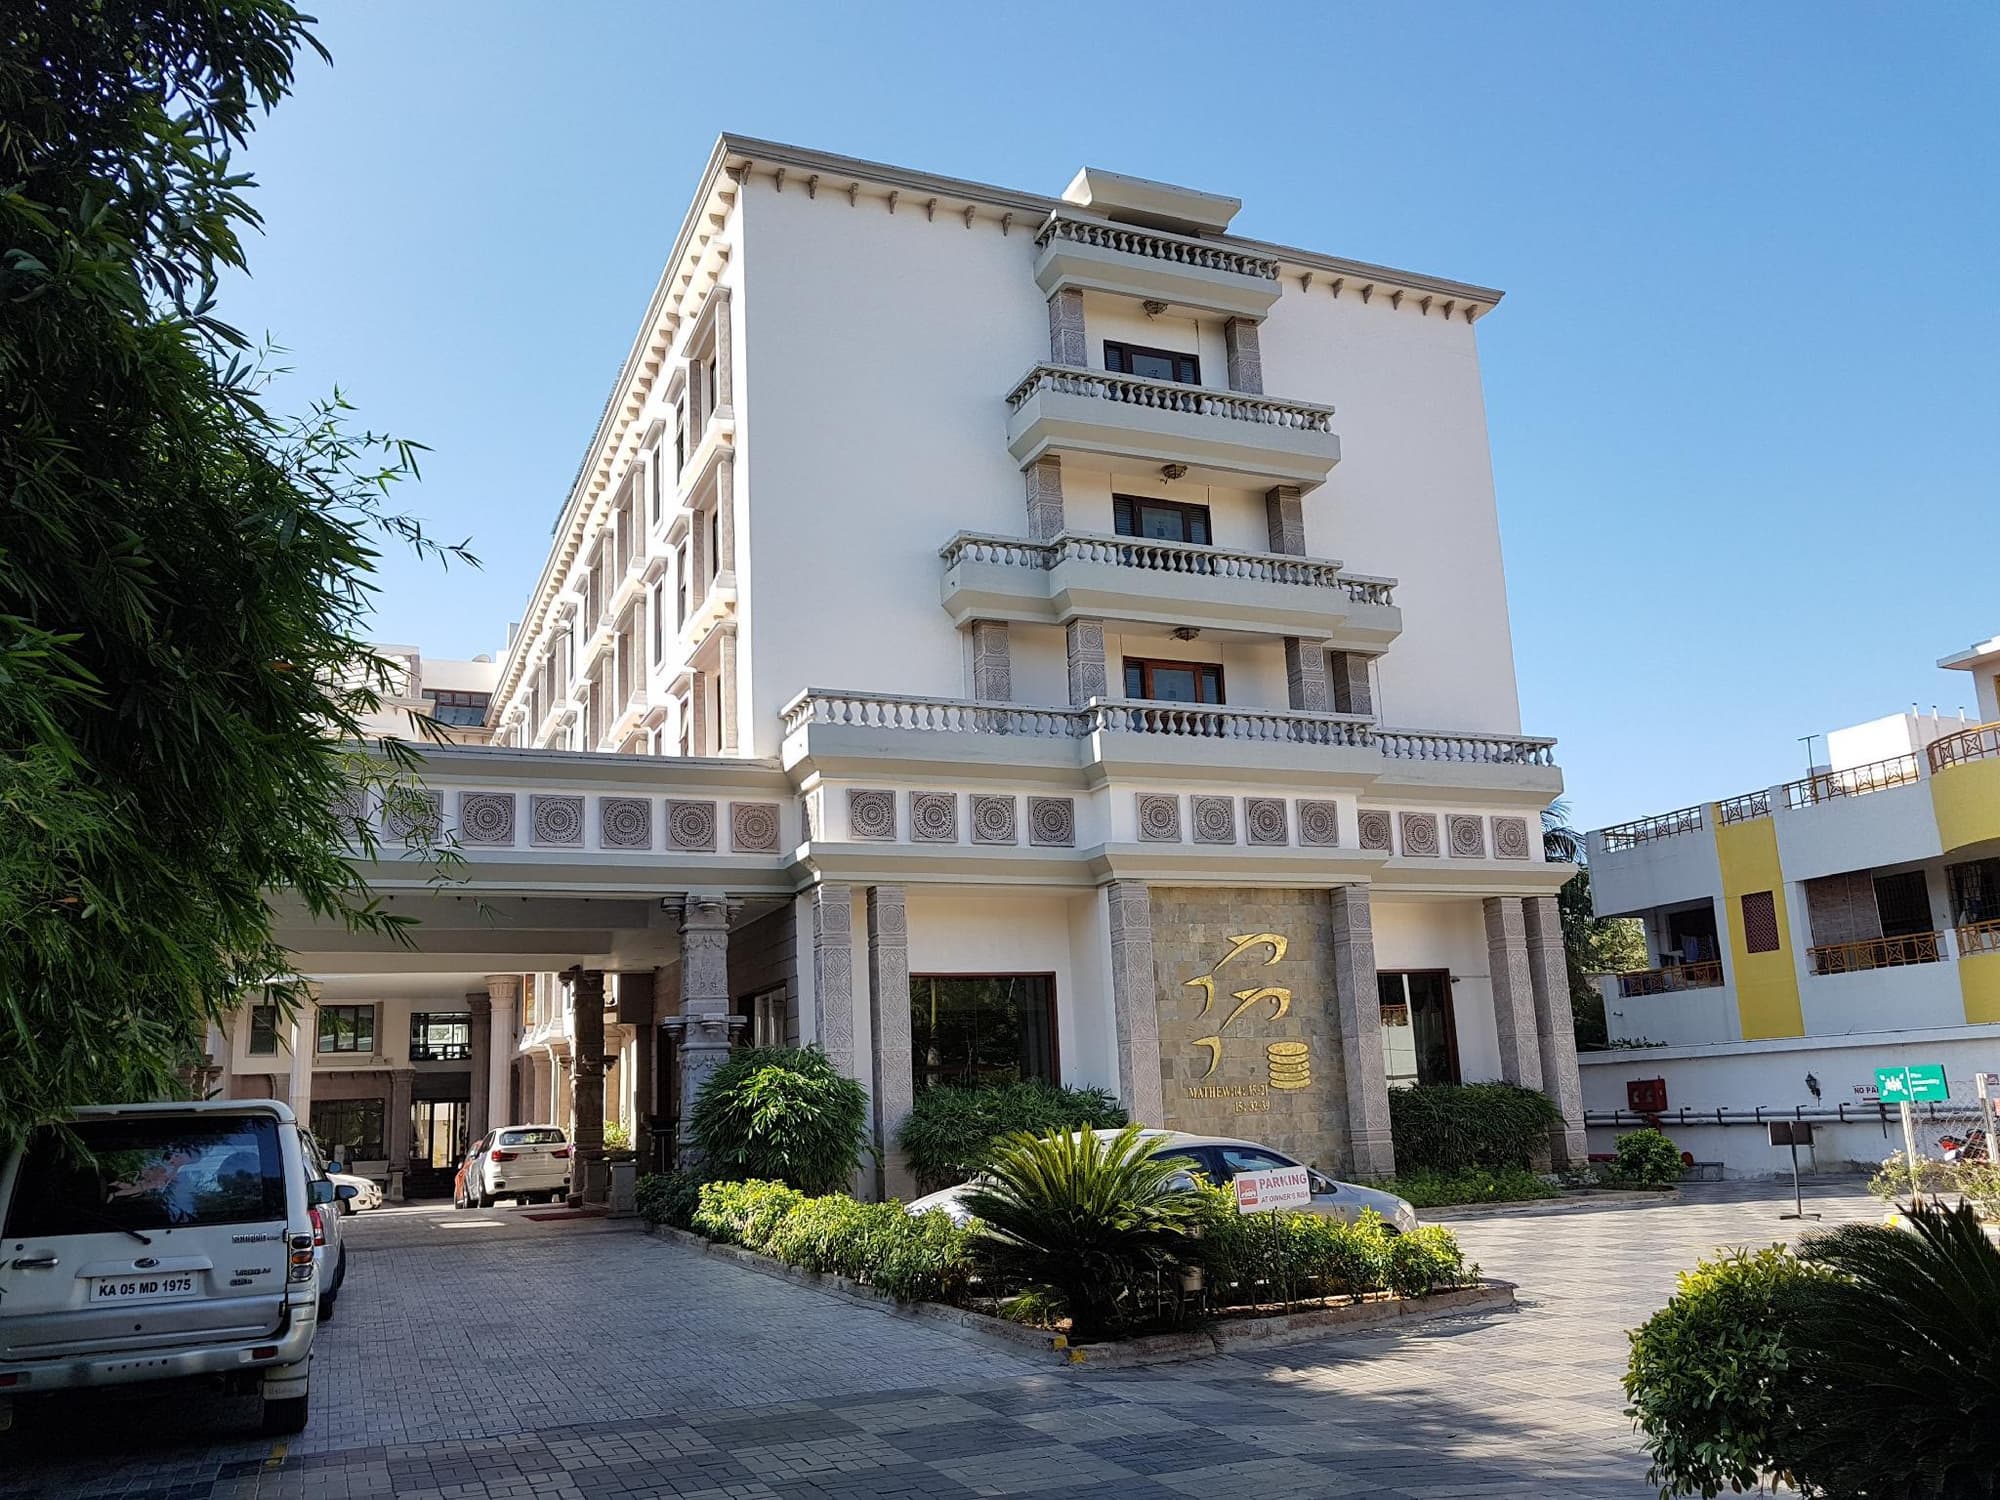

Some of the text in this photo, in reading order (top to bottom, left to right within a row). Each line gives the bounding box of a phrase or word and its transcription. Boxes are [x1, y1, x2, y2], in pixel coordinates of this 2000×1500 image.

[1854, 1087, 1864, 1095] NO
[1260, 1174, 1307, 1190] PARKING
[1261, 1195, 1268, 1203] AT
[99, 1279, 192, 1297] KA 05 MD 1975
